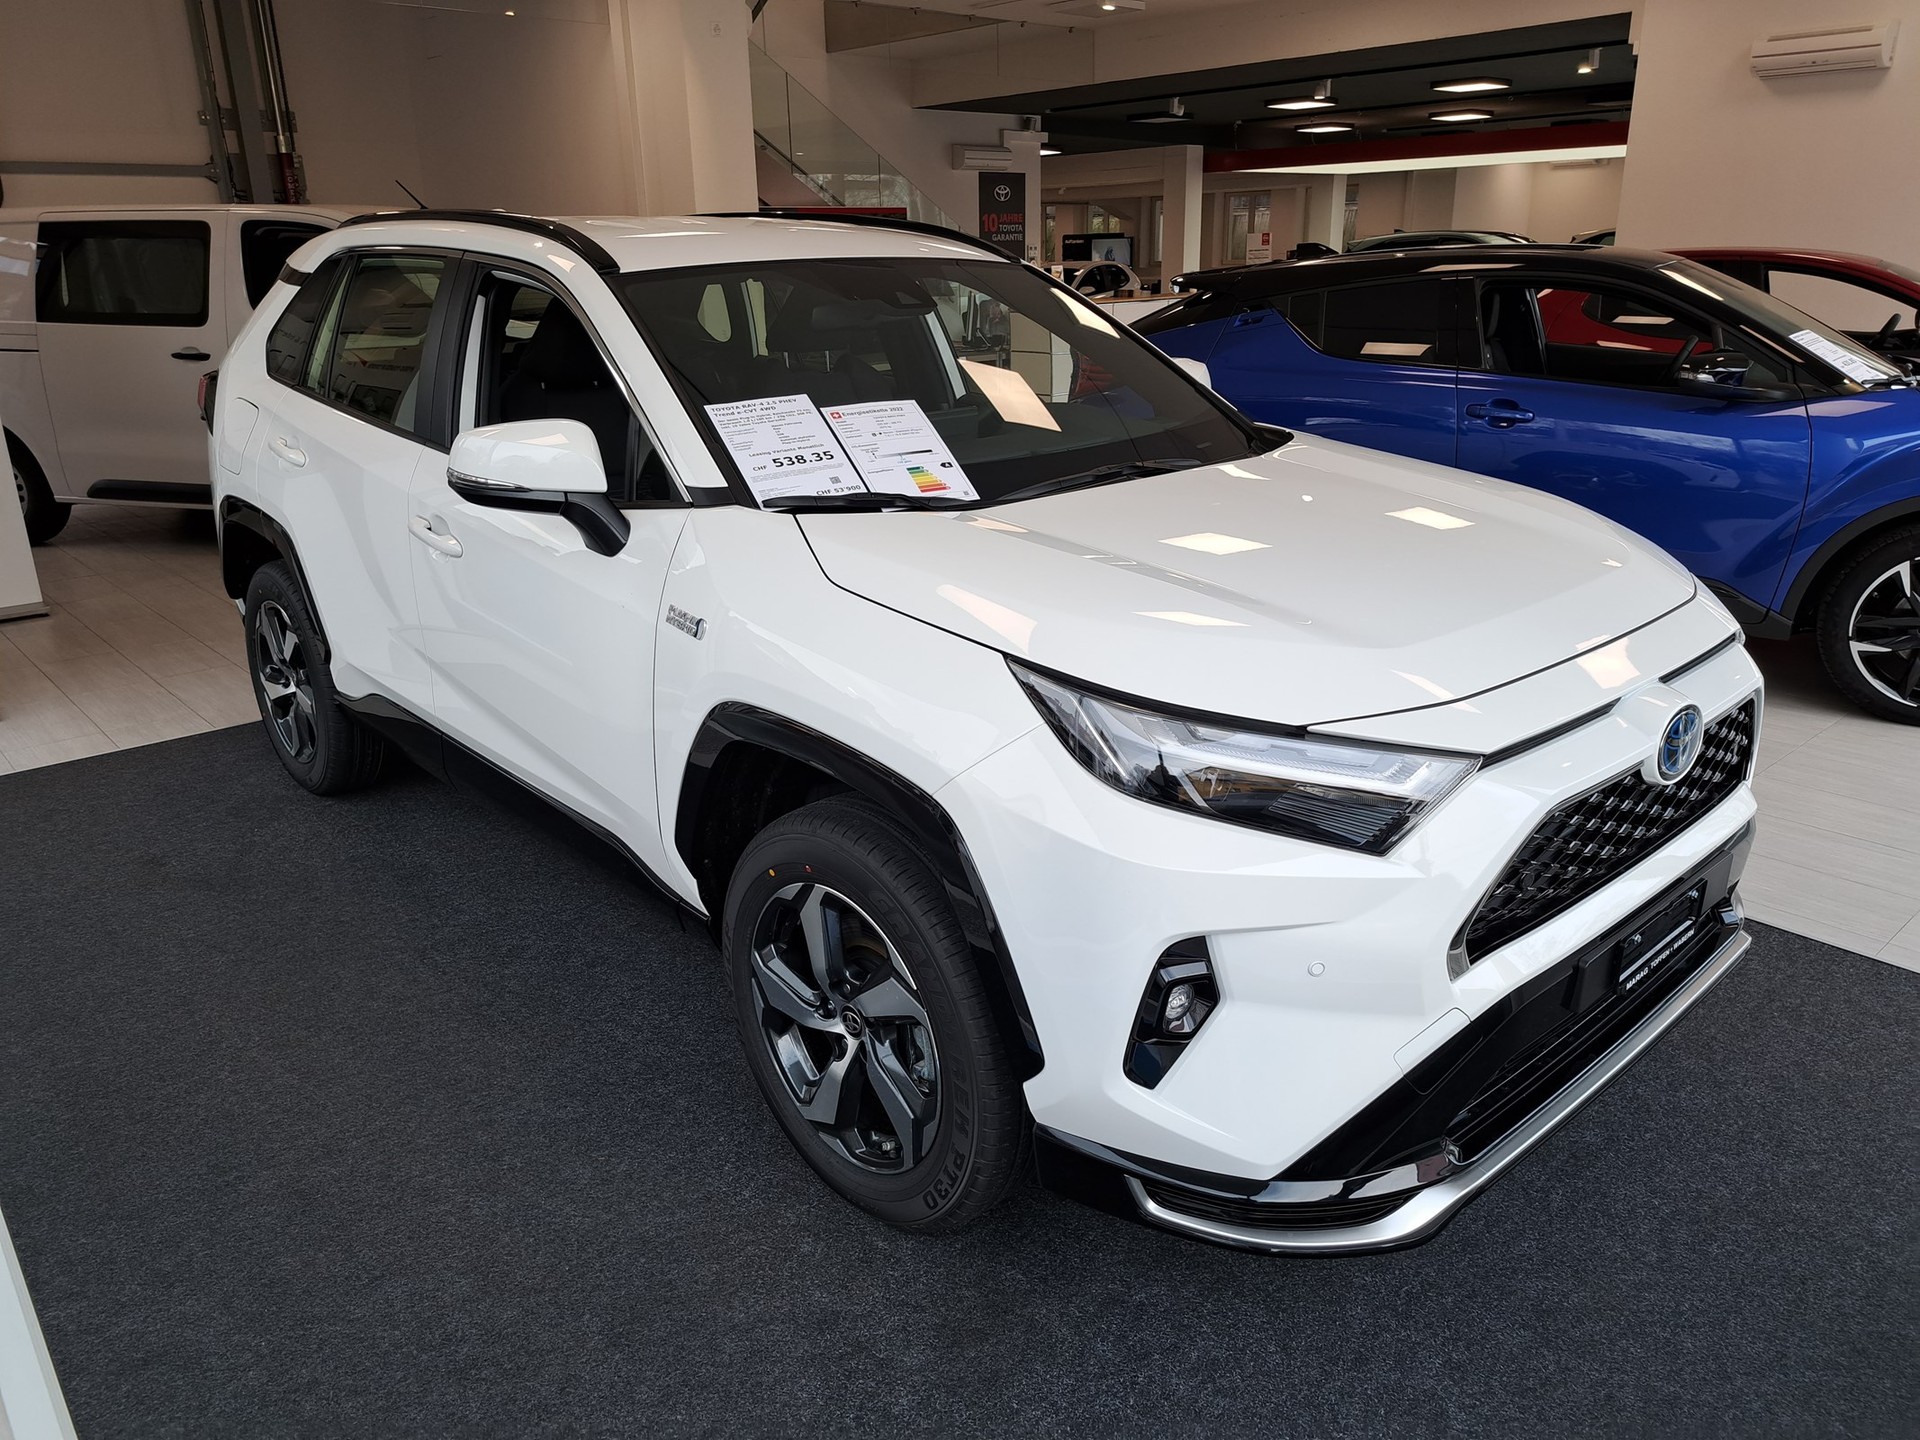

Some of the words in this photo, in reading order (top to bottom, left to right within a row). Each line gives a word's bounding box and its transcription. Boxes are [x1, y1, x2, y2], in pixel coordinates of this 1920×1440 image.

[982, 213, 998, 232] 10
[999, 213, 1023, 223] JAHRE
[999, 224, 1023, 232] TOYOTA
[992, 233, 1023, 241] GARANTIE
[711, 405, 740, 413] TOYOTA
[772, 450, 834, 468] 538.35
[833, 484, 861, 493] 53'900
[1626, 967, 1649, 990] MARAG
[1650, 948, 1670, 969] TOFFEN
[1673, 928, 1695, 950] WABERN
[922, 1142, 967, 1212] PT30
